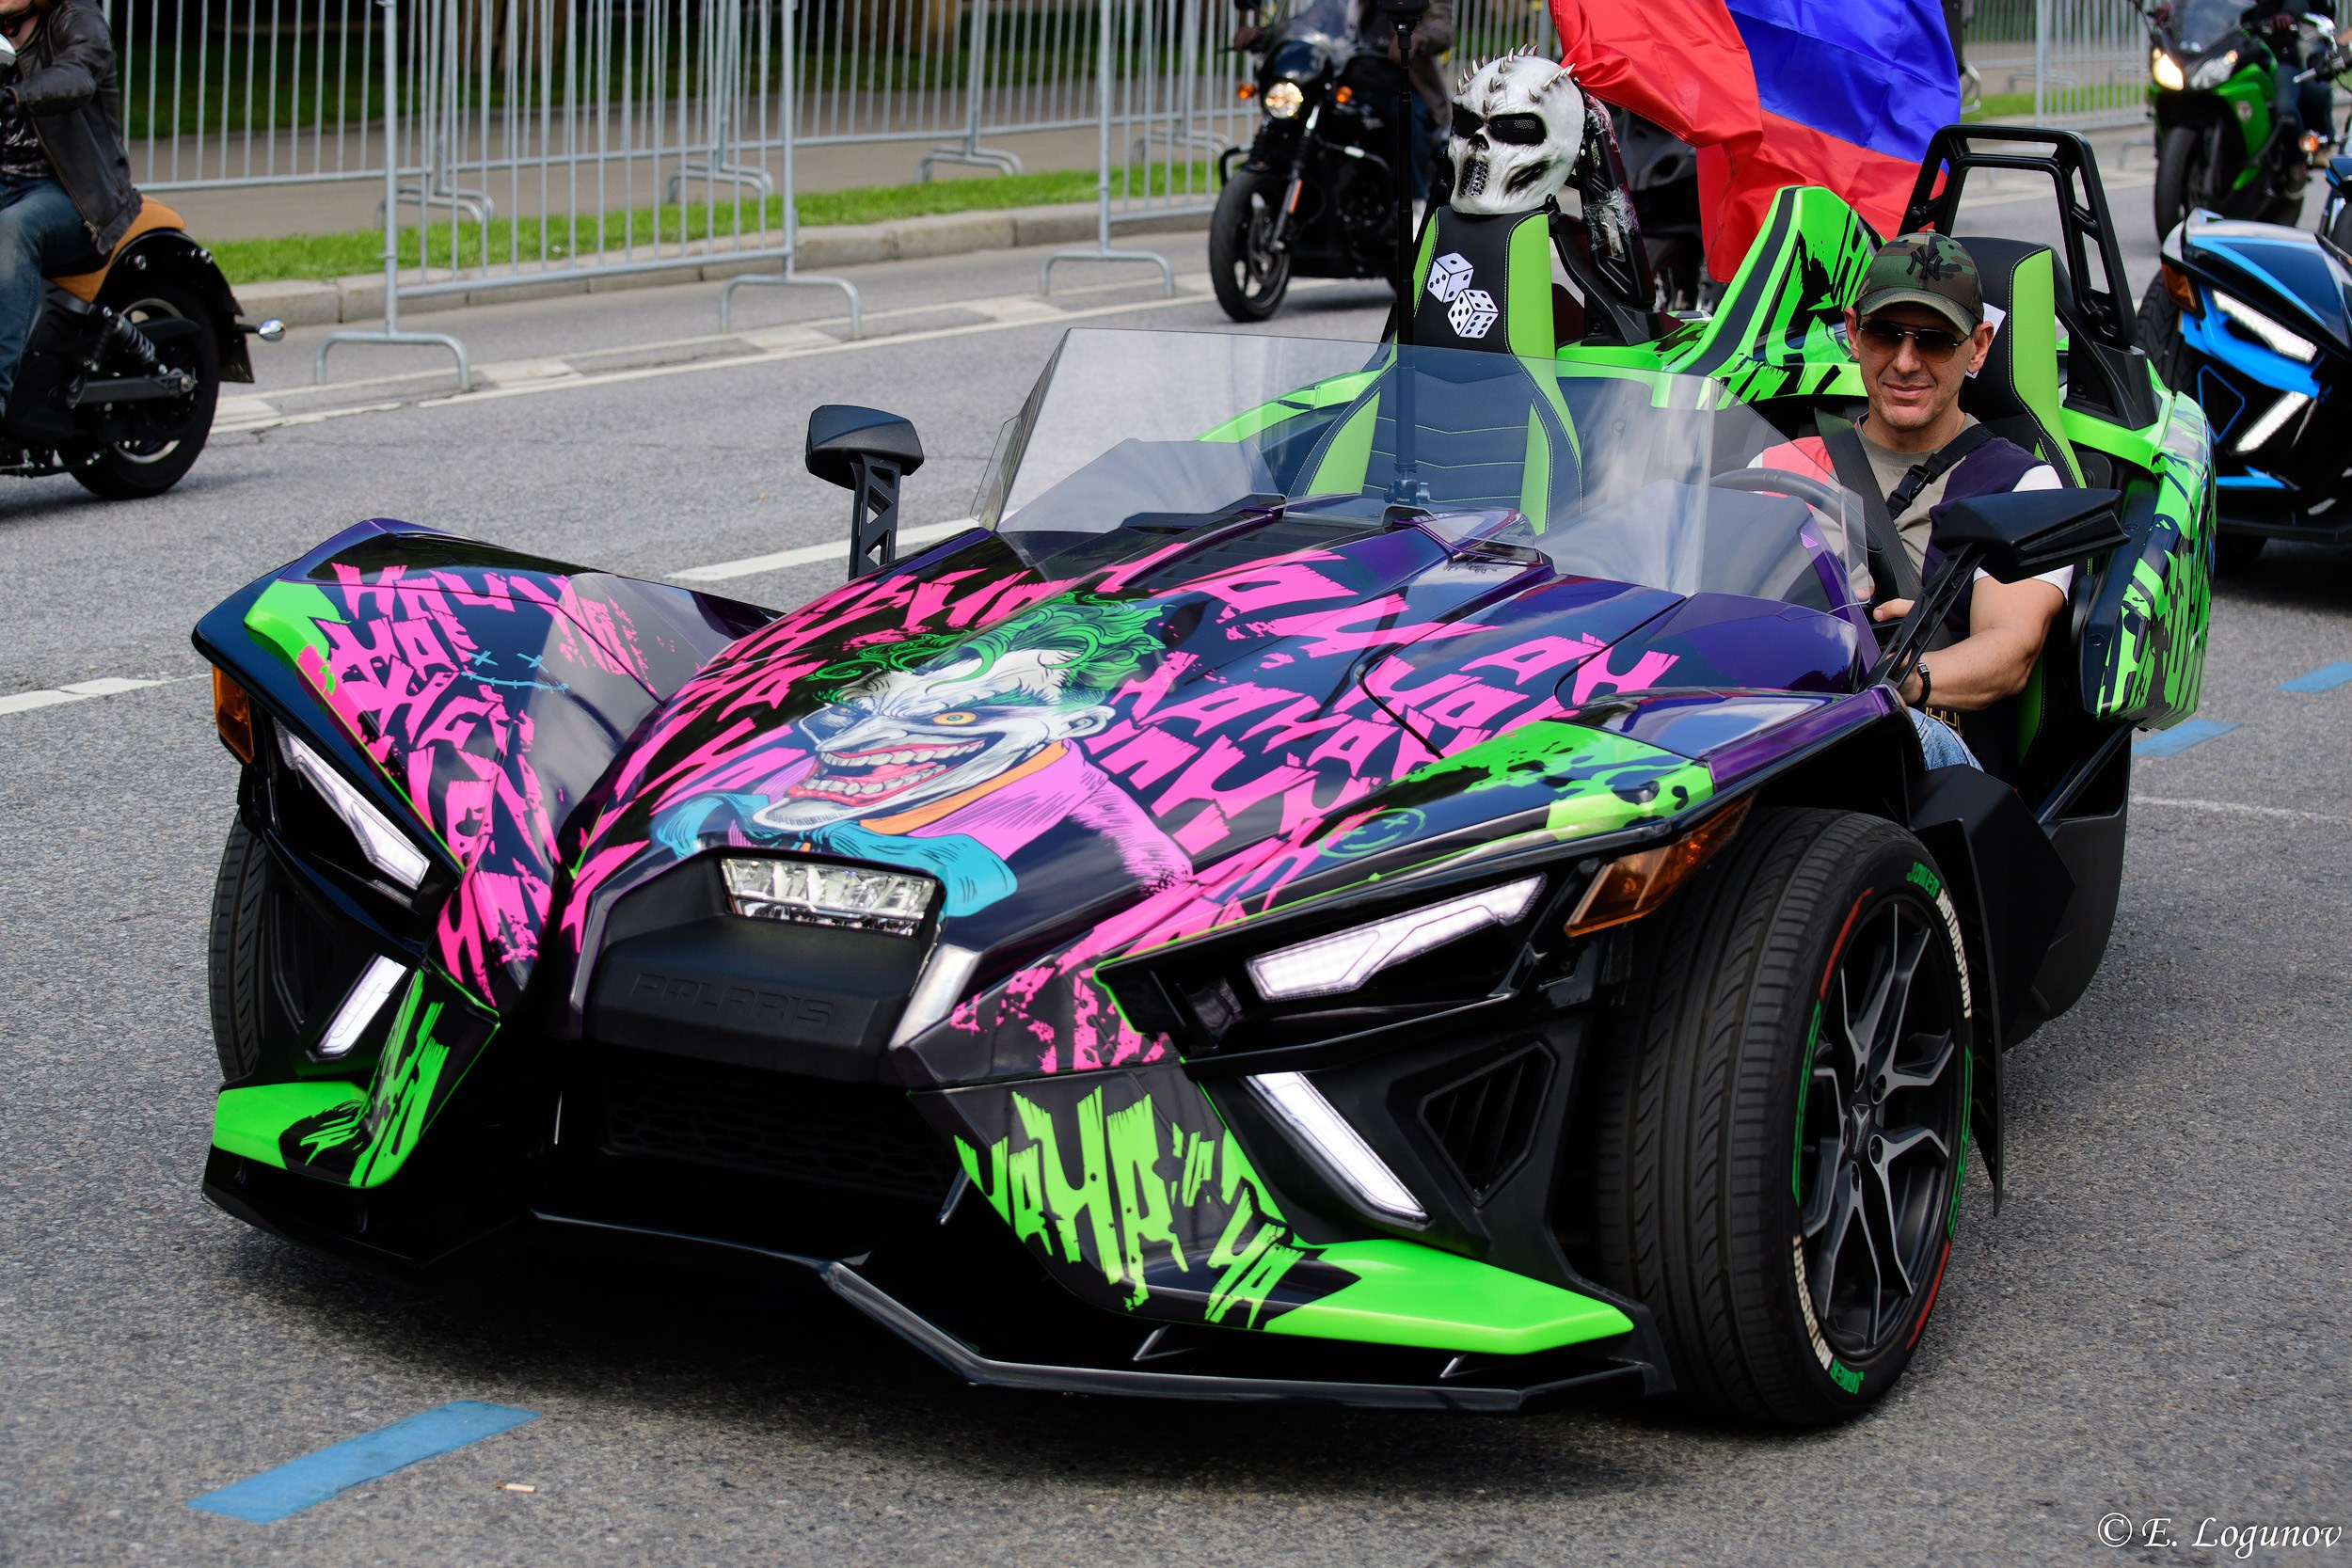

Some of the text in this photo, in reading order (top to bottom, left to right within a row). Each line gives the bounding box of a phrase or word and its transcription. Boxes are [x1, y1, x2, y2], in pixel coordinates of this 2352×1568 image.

[1906, 246, 1944, 281] NY
[1906, 861, 1972, 1019] JOKER MOTORSPORT
[628, 972, 834, 1025] POLARIS
